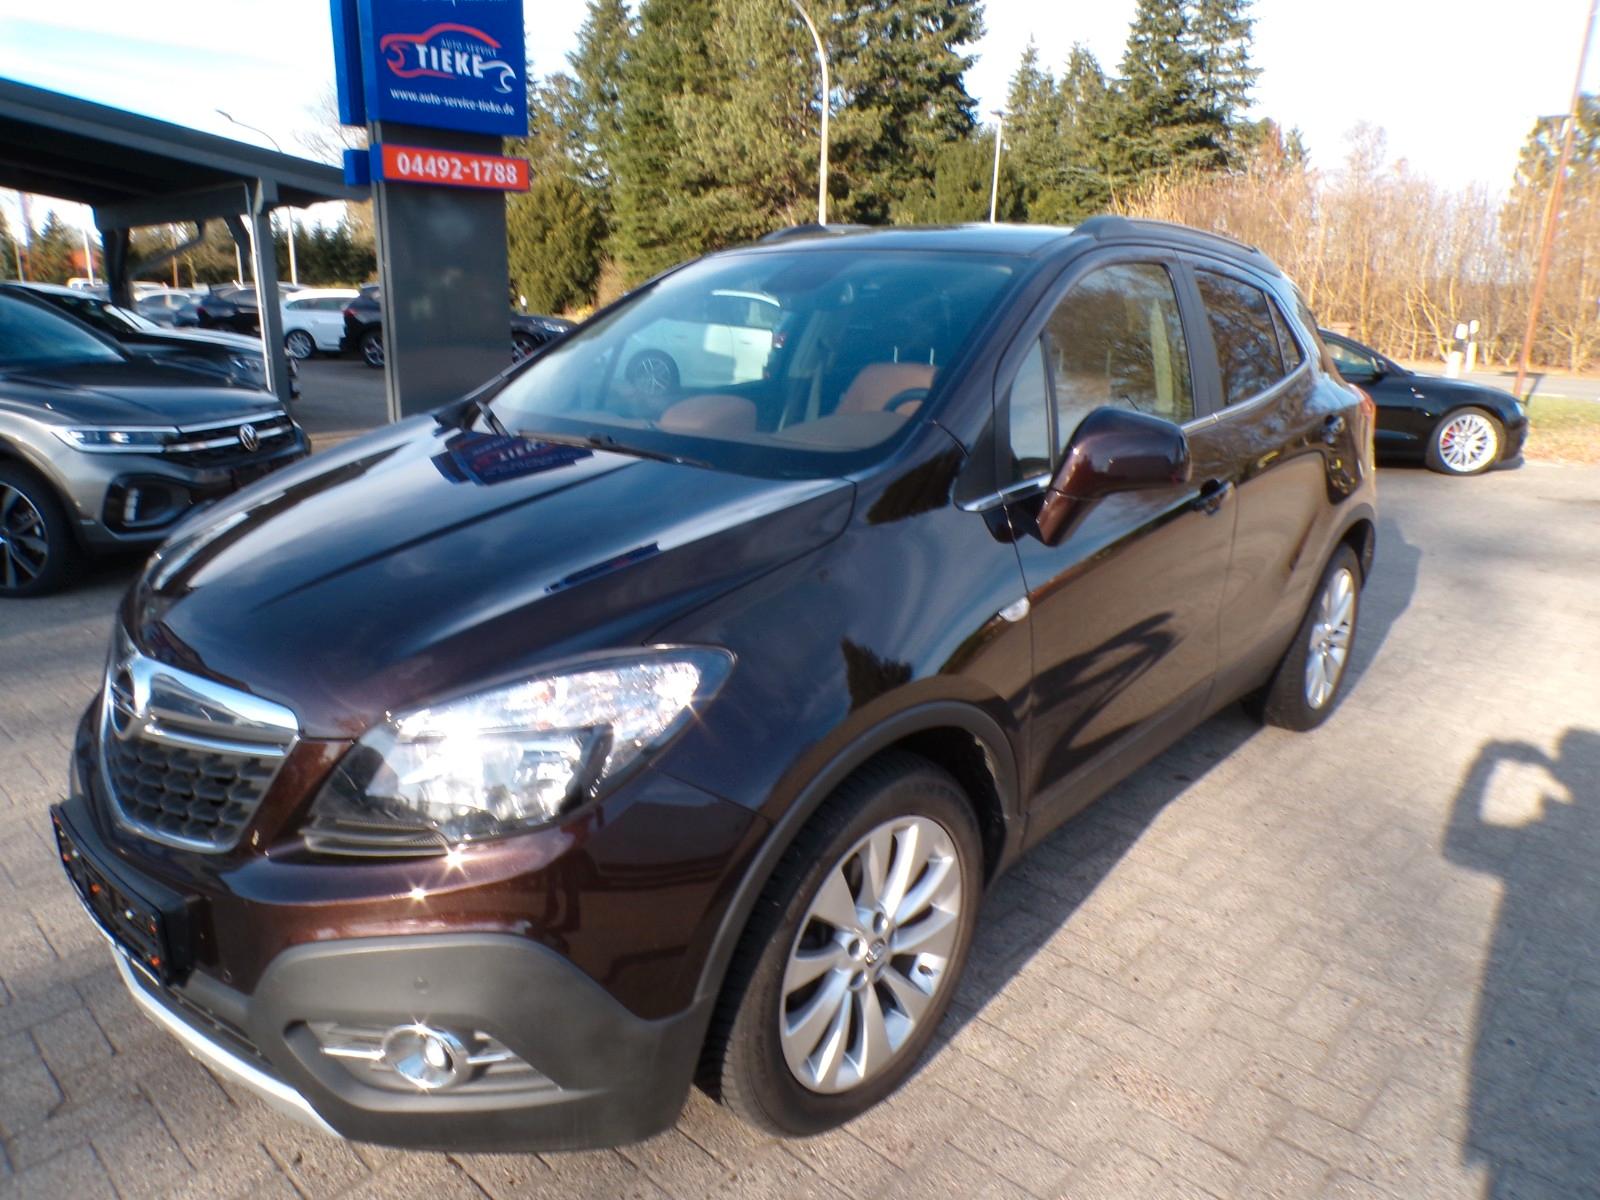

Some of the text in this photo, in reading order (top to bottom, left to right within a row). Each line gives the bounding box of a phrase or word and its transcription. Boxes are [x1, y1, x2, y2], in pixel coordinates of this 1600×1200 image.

[415, 44, 485, 79] TIEKE
[389, 87, 515, 116] www.auto-service-tieke.de
[396, 152, 518, 185] 04492-1788
